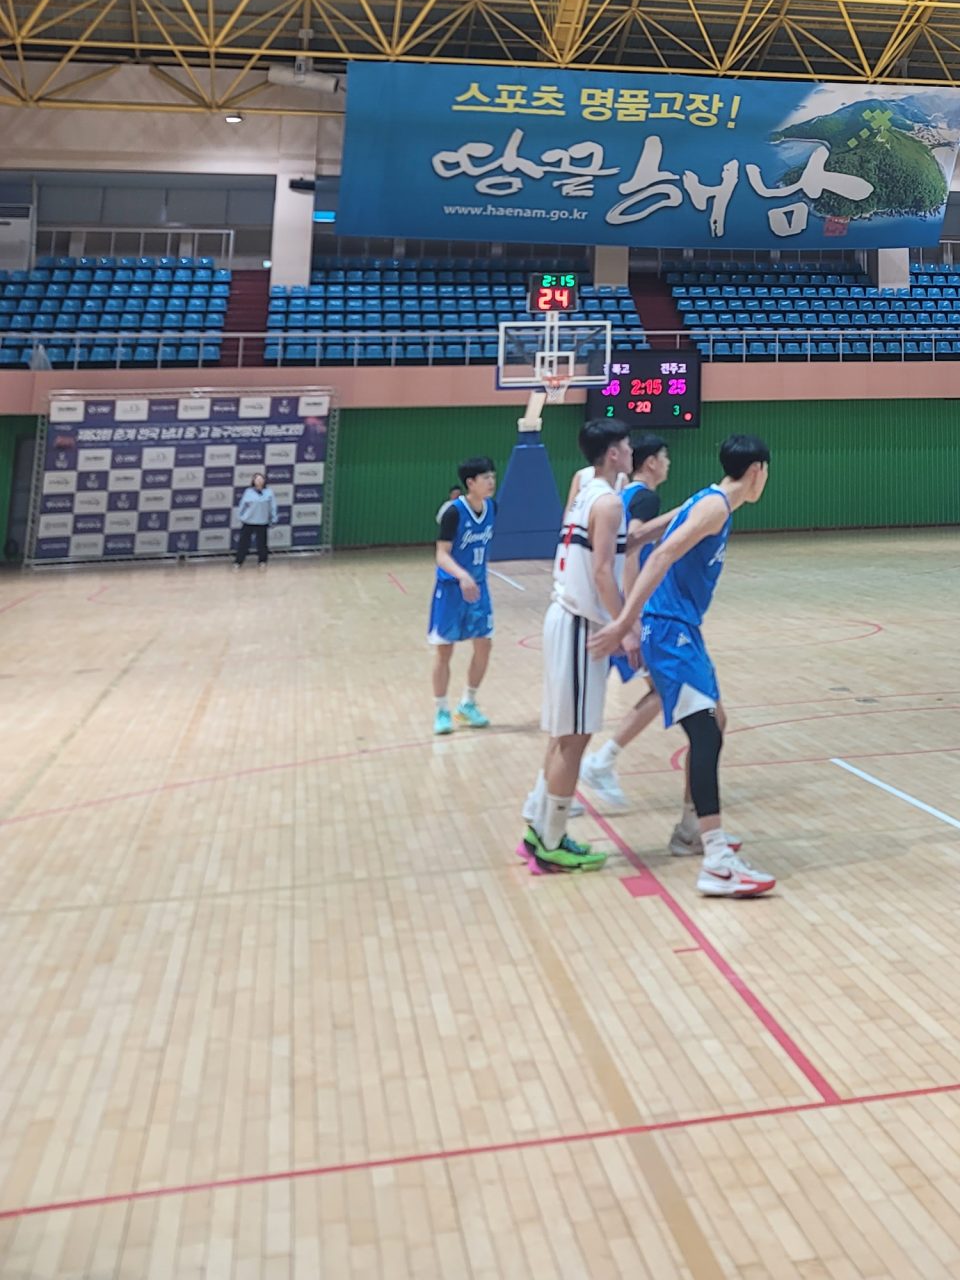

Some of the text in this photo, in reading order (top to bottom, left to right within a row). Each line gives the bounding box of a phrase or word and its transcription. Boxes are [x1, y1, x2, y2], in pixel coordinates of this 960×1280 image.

[452, 82, 742, 129] 스포츠 명품고장!
[605, 135, 875, 237] 해남
[443, 204, 588, 221] www.haenam.go.kr
[542, 274, 575, 287] 2:15
[538, 288, 569, 310] 24
[630, 379, 663, 396] 2:15
[668, 379, 686, 395] 25
[606, 405, 614, 417] 2
[672, 404, 680, 416] 3
